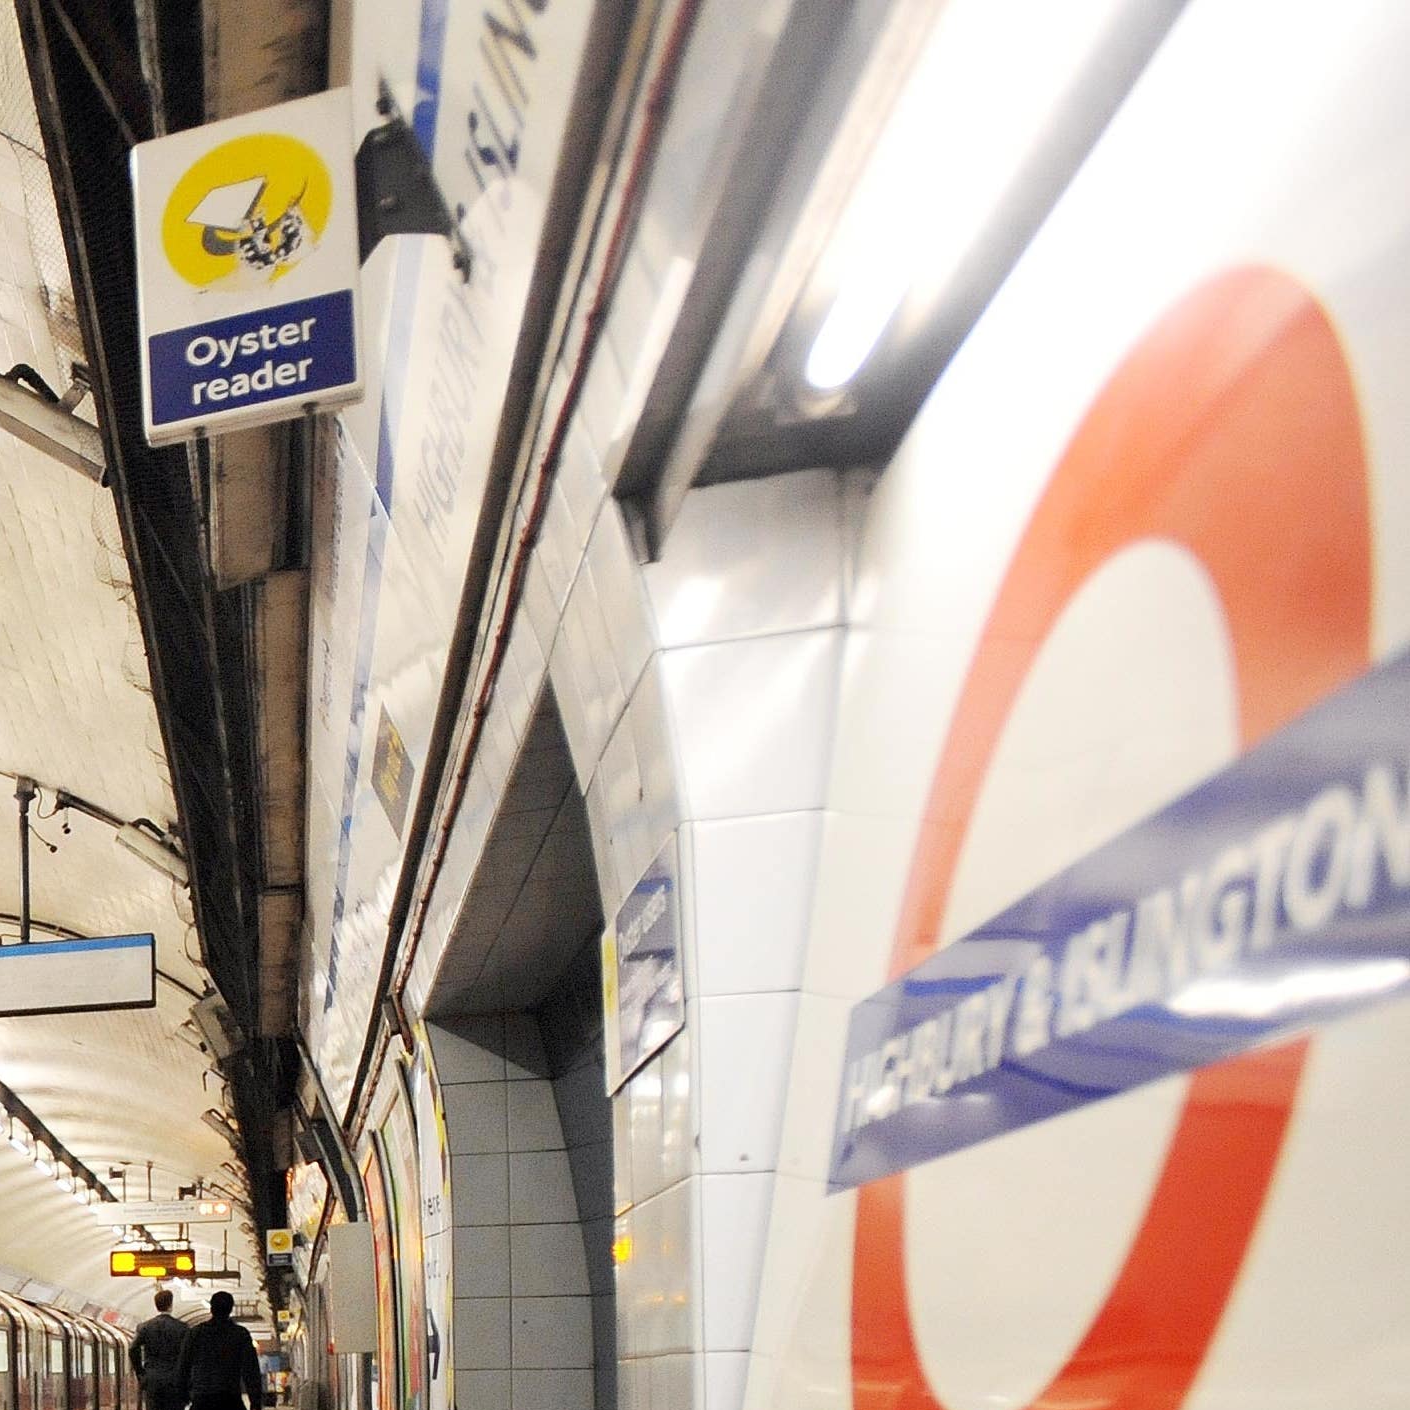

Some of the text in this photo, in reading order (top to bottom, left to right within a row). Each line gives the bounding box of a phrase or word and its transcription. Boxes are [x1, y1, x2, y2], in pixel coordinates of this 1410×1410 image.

[185, 317, 317, 368] Oyster
[192, 357, 313, 405] reader
[842, 760, 1410, 1132] HIGHBURY & ISLINGTON
